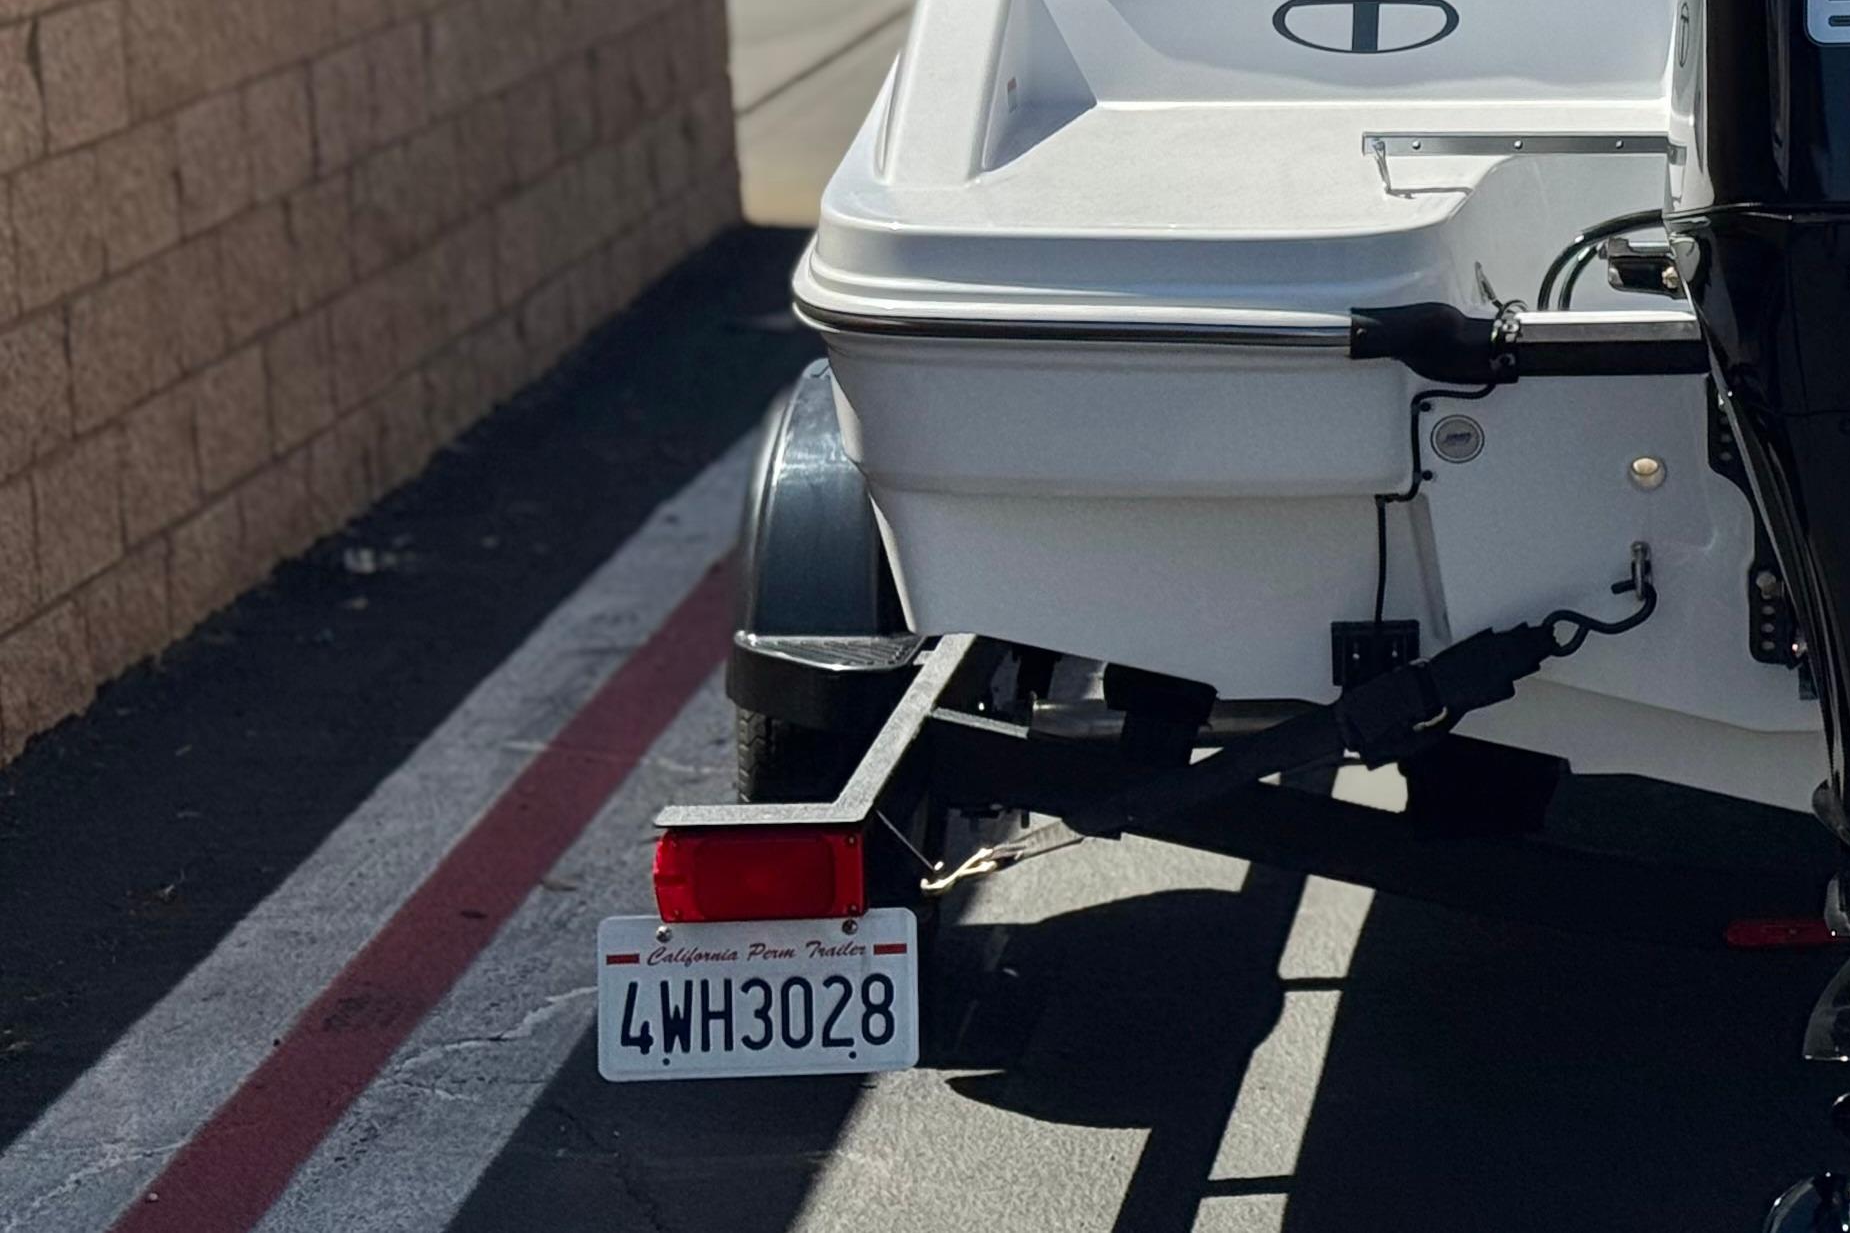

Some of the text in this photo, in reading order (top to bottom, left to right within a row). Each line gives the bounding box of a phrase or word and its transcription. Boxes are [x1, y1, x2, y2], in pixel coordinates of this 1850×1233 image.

[646, 940, 867, 968] California Perm Trailer
[619, 972, 896, 1056] 4WH3028
